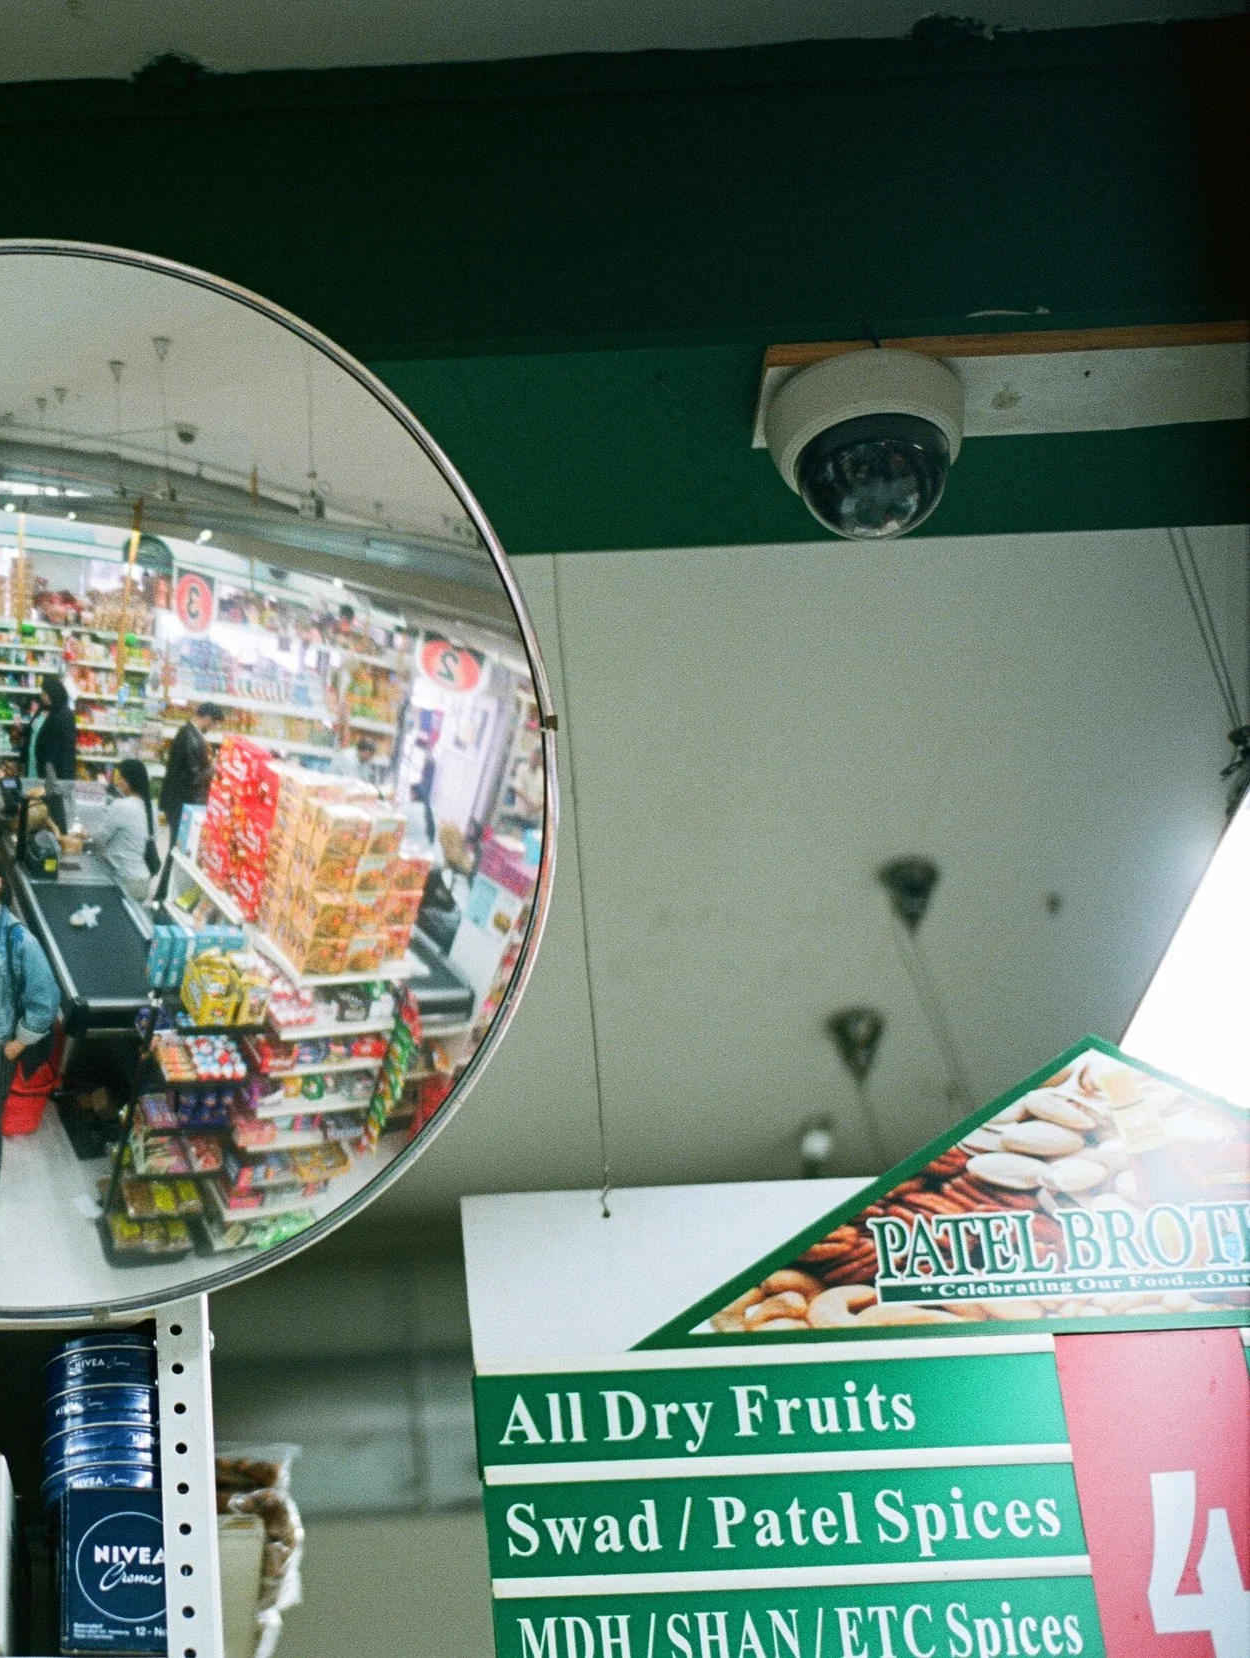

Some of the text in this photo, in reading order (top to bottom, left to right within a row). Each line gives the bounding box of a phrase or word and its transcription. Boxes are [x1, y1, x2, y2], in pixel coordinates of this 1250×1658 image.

[869, 1212, 1052, 1281] PATEL
[939, 1278, 1073, 1298] Celebrating
[1077, 1276, 1123, 1291] Our
[75, 1358, 104, 1368] NIVEA
[498, 1380, 917, 1453] All Dry Fruits
[72, 1476, 103, 1488] NIVEA
[506, 1486, 1061, 1558] Swad / Patel Spices
[94, 1545, 165, 1564] NIVEA
[1147, 1470, 1250, 1658] 4
[99, 1560, 162, 1591] Creme
[135, 1626, 146, 1637] 12
[517, 1614, 631, 1658] MDH
[666, 1609, 799, 1658] SHAN
[835, 1604, 937, 1658] ETC
[946, 1601, 1084, 1658] Spices
